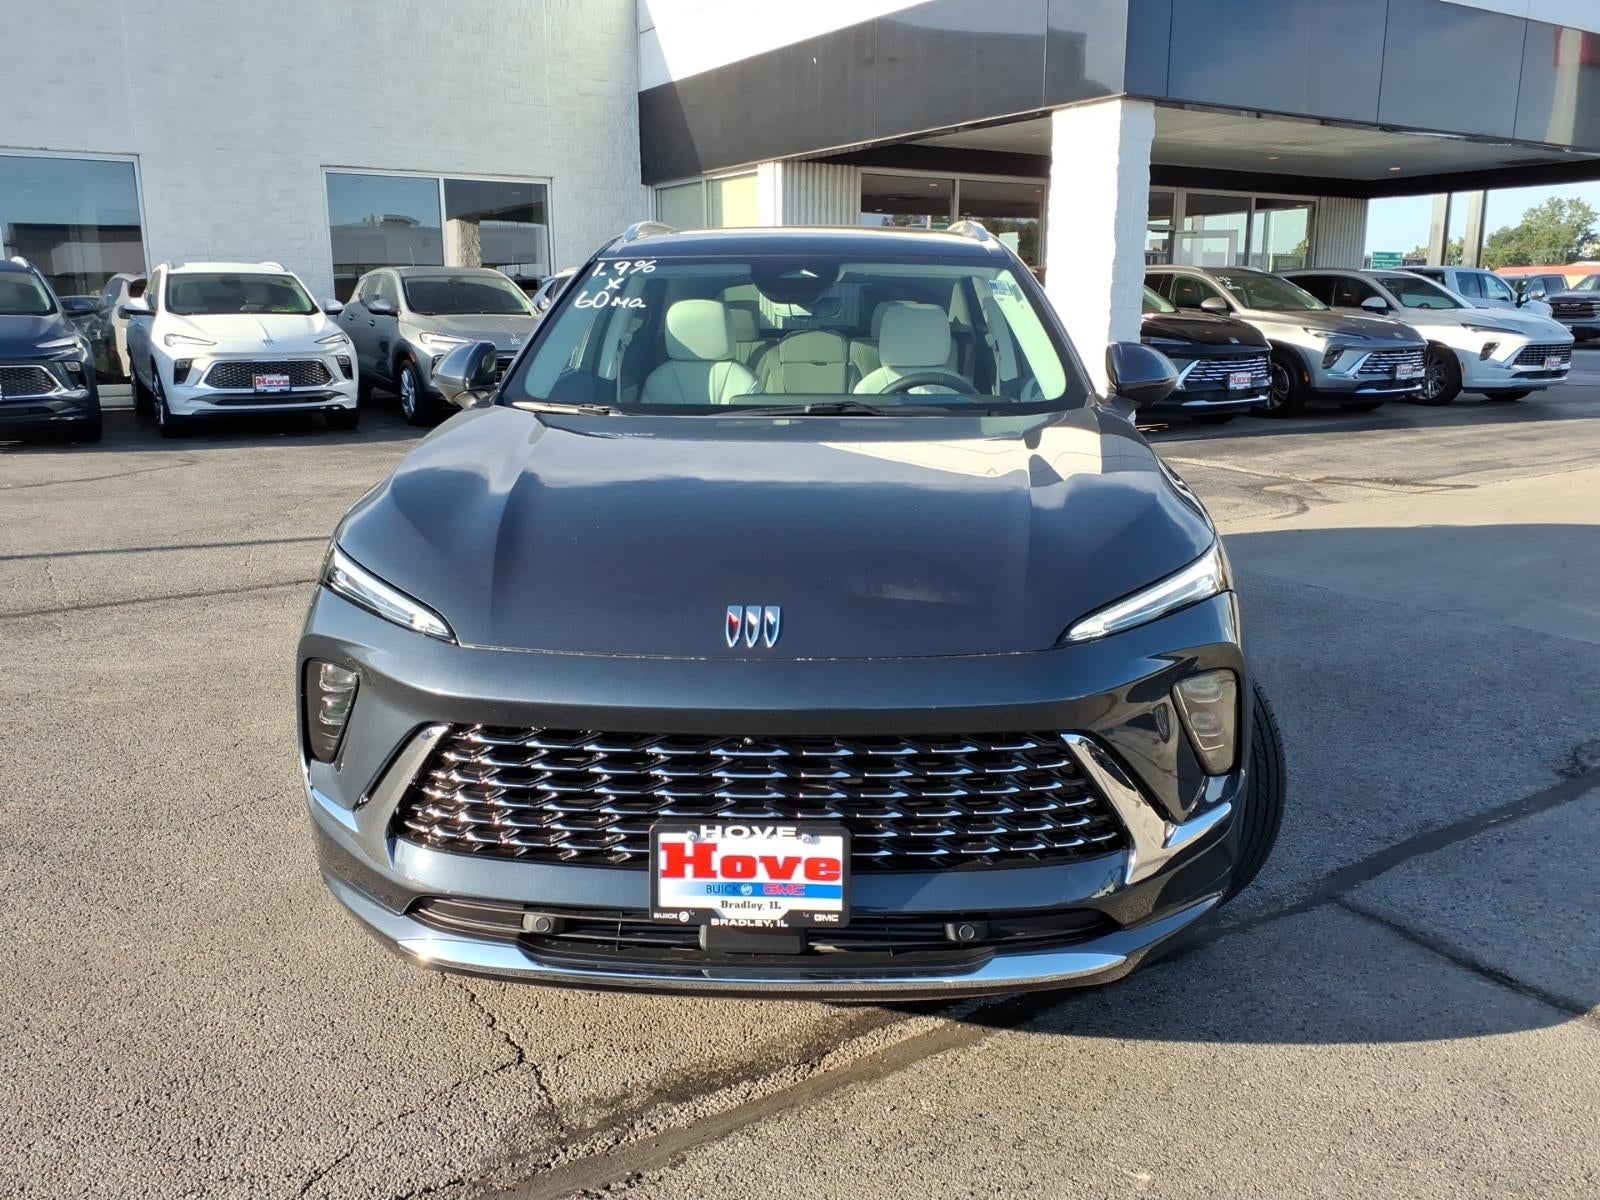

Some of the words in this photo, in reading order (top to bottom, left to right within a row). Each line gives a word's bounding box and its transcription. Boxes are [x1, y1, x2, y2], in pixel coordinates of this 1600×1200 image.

[592, 260, 657, 276] 1.9%
[700, 825, 798, 840] HOVE
[660, 842, 842, 881] Hove
[706, 884, 739, 894] BUICK
[763, 883, 805, 896] GMC
[721, 900, 765, 911] Bradley,
[769, 901, 782, 910] IL
[711, 918, 774, 928] BRADLEY,
[777, 919, 789, 928] IL
[814, 913, 840, 922] GMC
